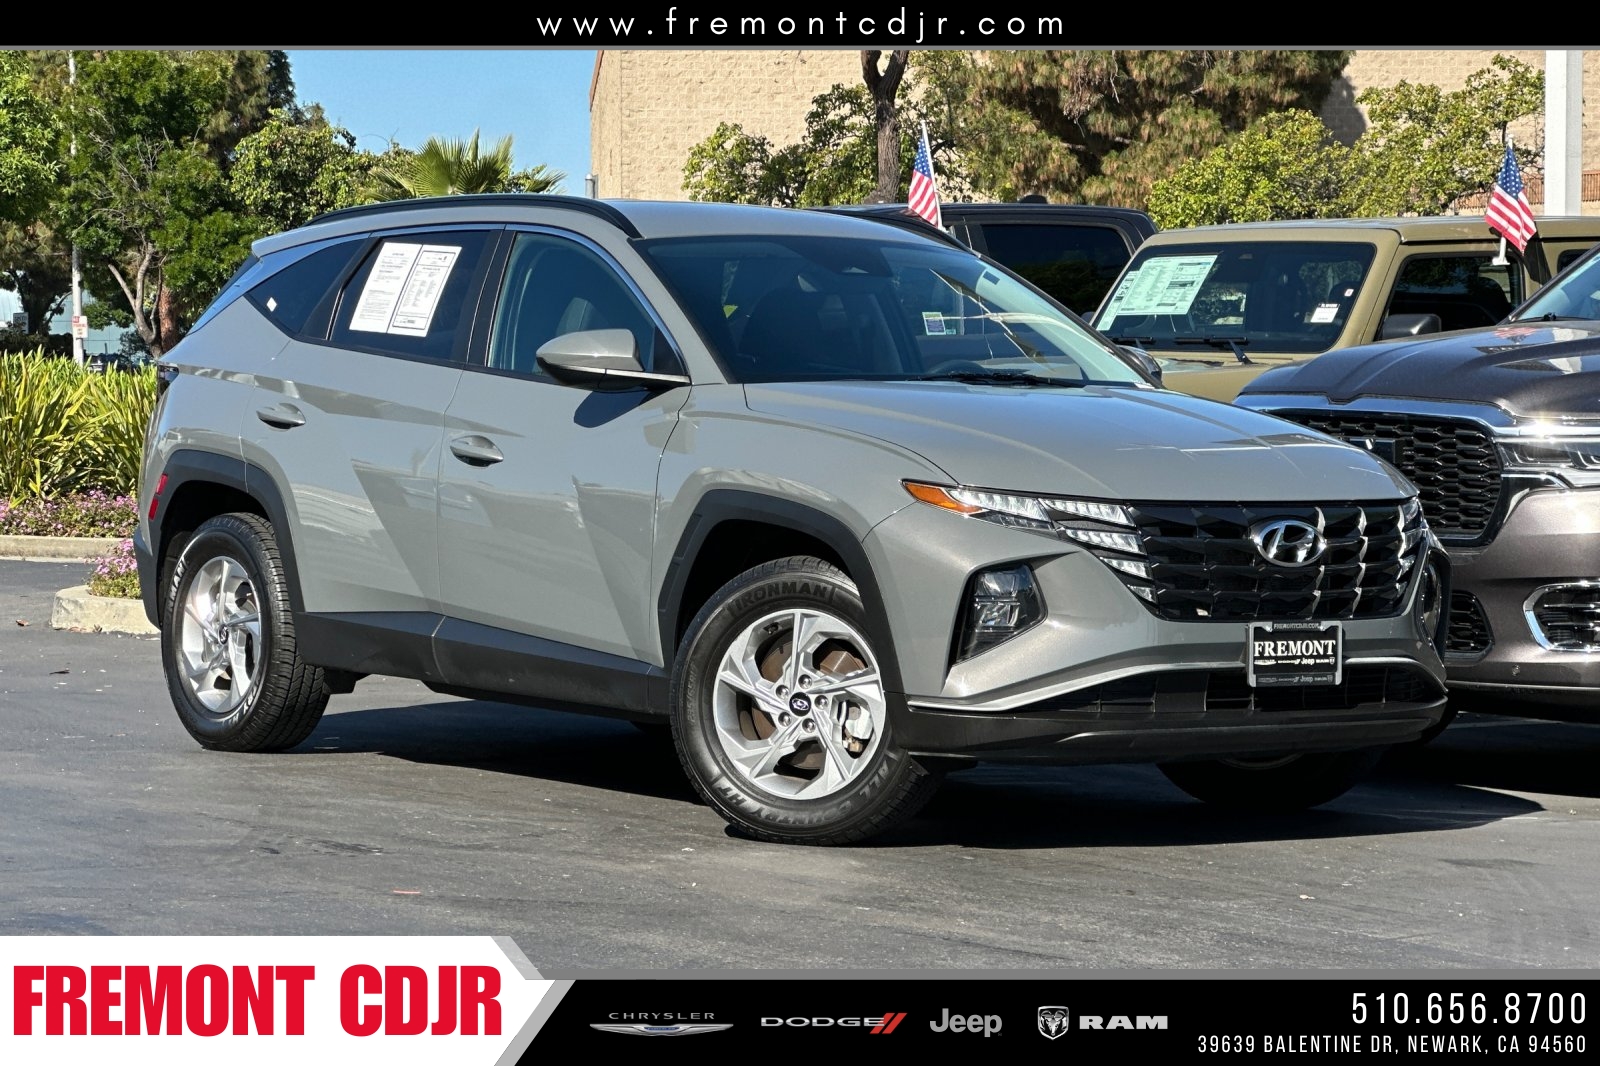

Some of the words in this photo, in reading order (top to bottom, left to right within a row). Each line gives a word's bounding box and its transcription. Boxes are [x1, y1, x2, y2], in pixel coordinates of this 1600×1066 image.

[736, 581, 828, 610] IRONMAN
[1254, 640, 1336, 657] FREMONT
[1300, 657, 1316, 666] Jeep
